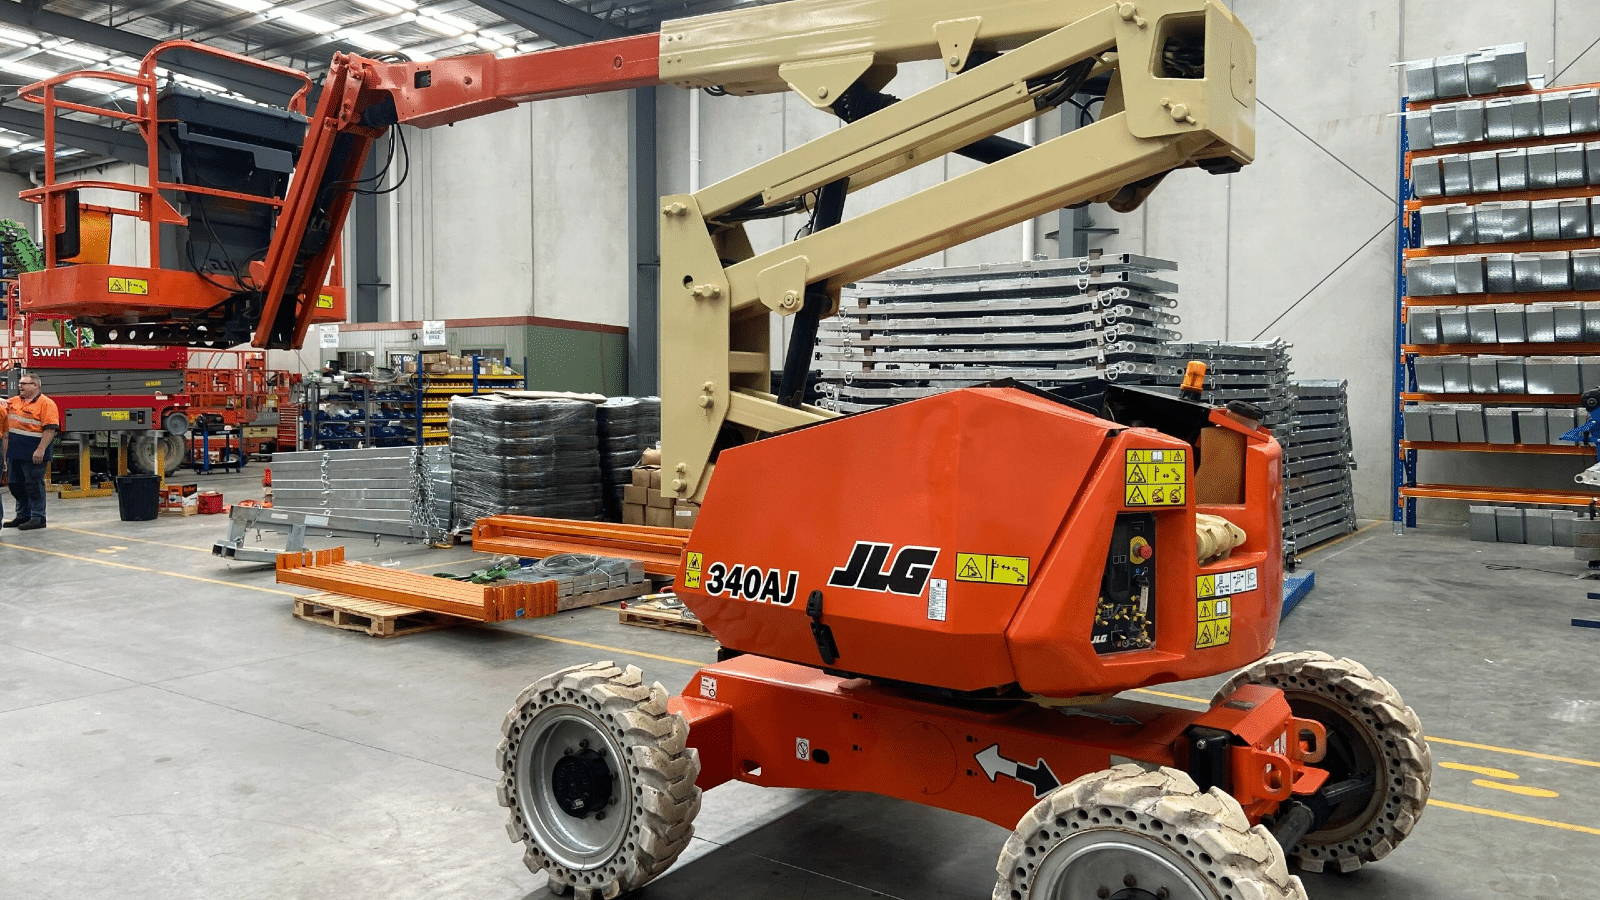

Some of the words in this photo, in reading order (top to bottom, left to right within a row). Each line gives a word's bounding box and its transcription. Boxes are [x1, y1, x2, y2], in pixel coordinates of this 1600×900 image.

[32, 348, 72, 357] SWIFT
[826, 540, 941, 597] JLG
[705, 561, 799, 607] 340AJ
[1090, 634, 1108, 643] JLG
